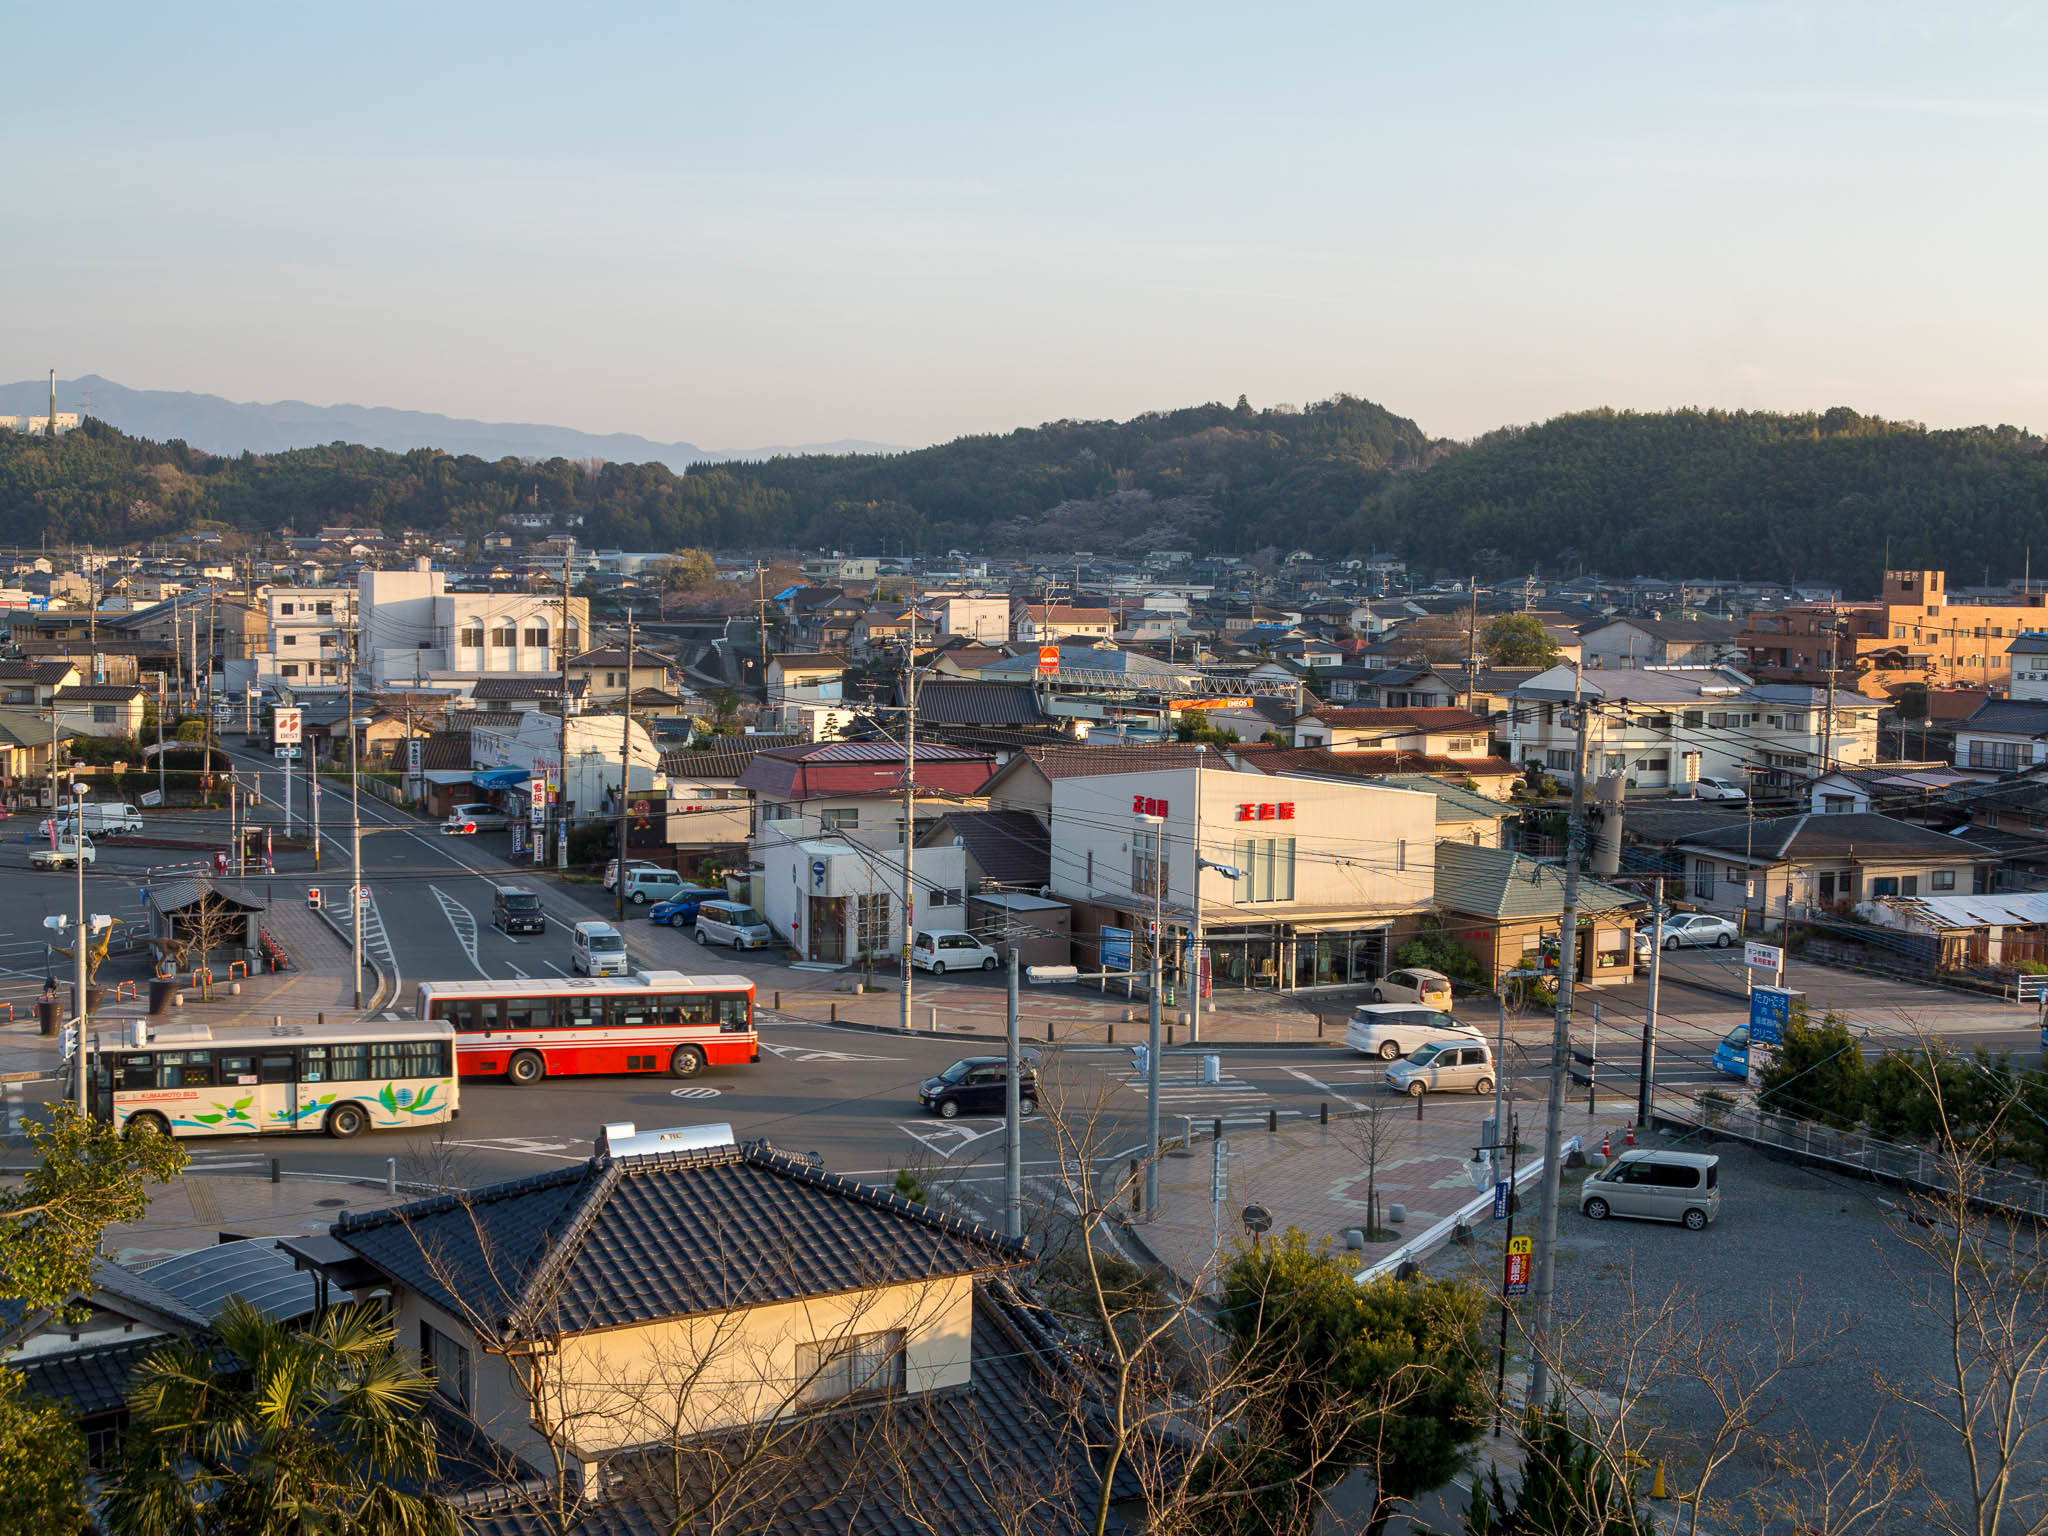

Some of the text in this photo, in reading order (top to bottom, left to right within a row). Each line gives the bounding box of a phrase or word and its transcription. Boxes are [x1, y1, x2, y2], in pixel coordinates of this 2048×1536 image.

[1227, 700, 1248, 708] ENEOS
[1133, 795, 1168, 818] 正直屋
[1239, 802, 1295, 821] 正直屋
